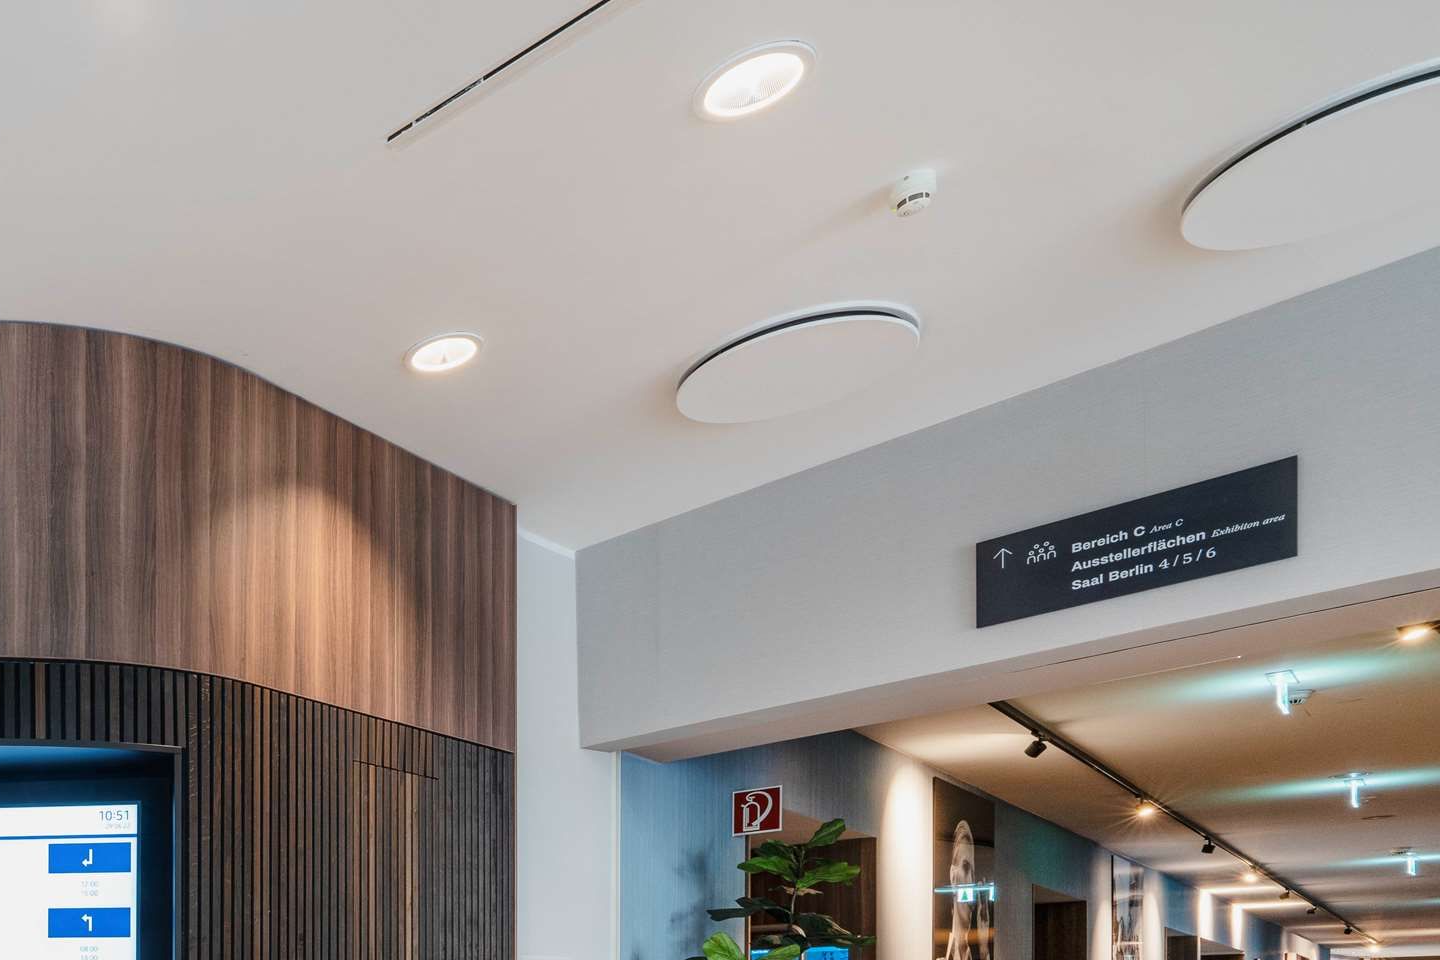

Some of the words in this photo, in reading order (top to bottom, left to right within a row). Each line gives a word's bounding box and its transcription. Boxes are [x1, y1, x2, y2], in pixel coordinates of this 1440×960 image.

[1149, 522, 1172, 534] Area
[1175, 518, 1184, 527] C
[1262, 513, 1286, 526] area
[1071, 531, 1128, 553] Bereich
[1133, 525, 1146, 537] C
[1071, 531, 1206, 572] Ausstellerflächen
[1071, 573, 1104, 590] Saal
[1108, 563, 1154, 582] Berlin
[99, 809, 129, 821] 10:51
